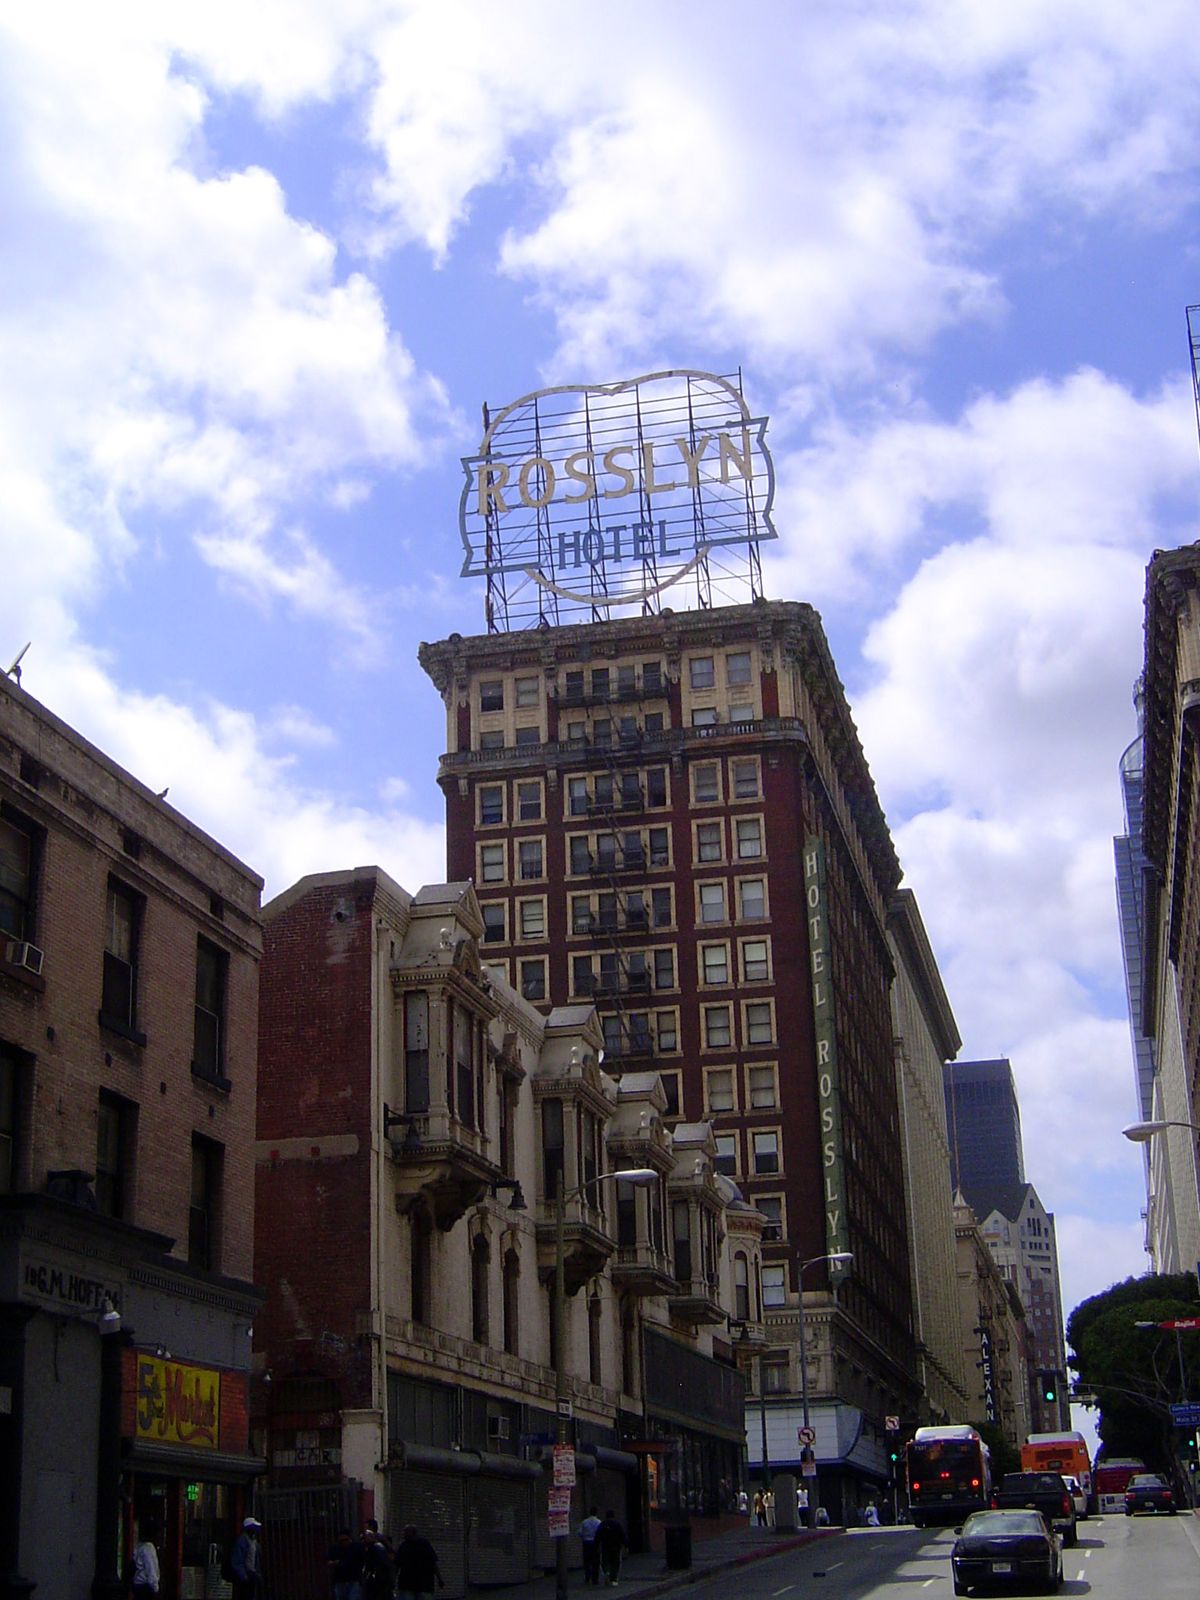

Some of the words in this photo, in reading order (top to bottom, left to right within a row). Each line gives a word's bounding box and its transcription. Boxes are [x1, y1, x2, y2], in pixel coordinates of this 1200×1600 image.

[477, 429, 753, 516] ROSSLYN
[558, 520, 680, 571] HOTEL
[805, 851, 827, 1006] HOTEL
[817, 1039, 844, 1273] ROSSLYN
